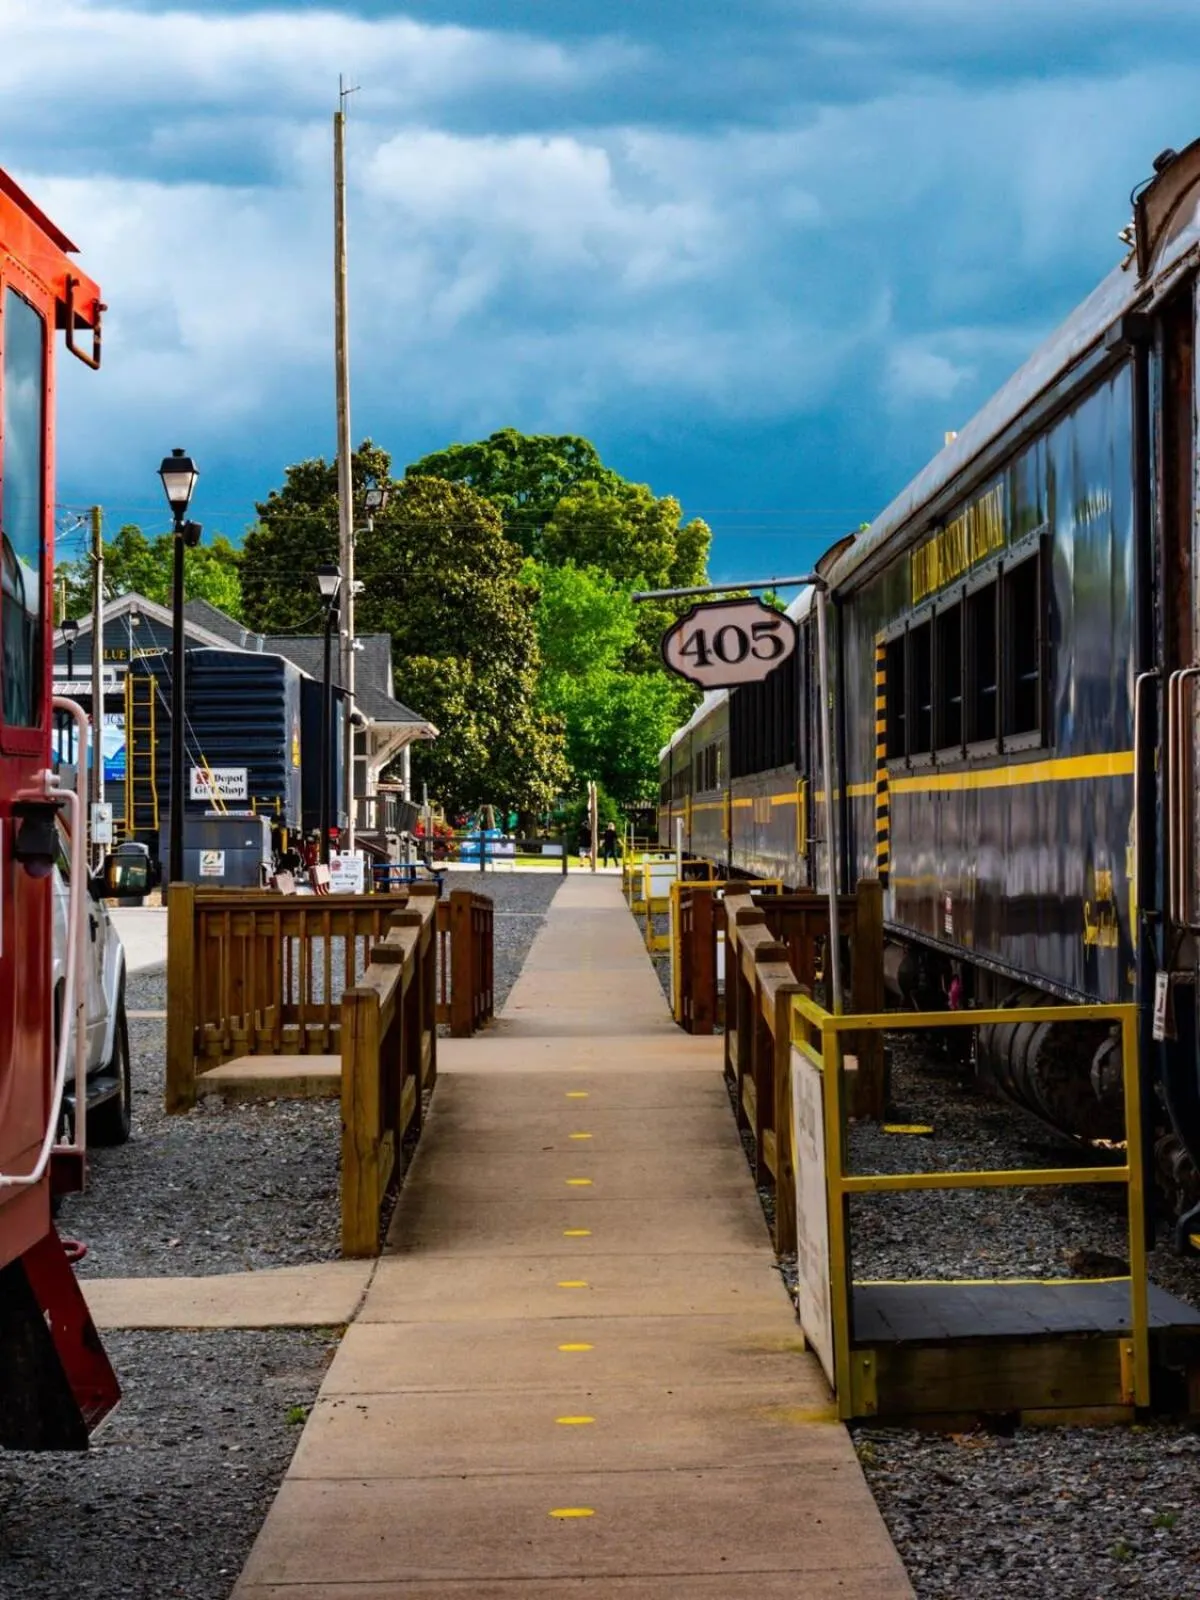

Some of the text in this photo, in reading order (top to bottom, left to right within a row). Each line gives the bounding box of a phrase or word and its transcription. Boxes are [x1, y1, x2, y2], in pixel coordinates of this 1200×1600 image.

[679, 621, 785, 668] 405
[103, 647, 127, 660] LUE
[214, 774, 243, 785] Depot
[218, 785, 245, 796] Shop
